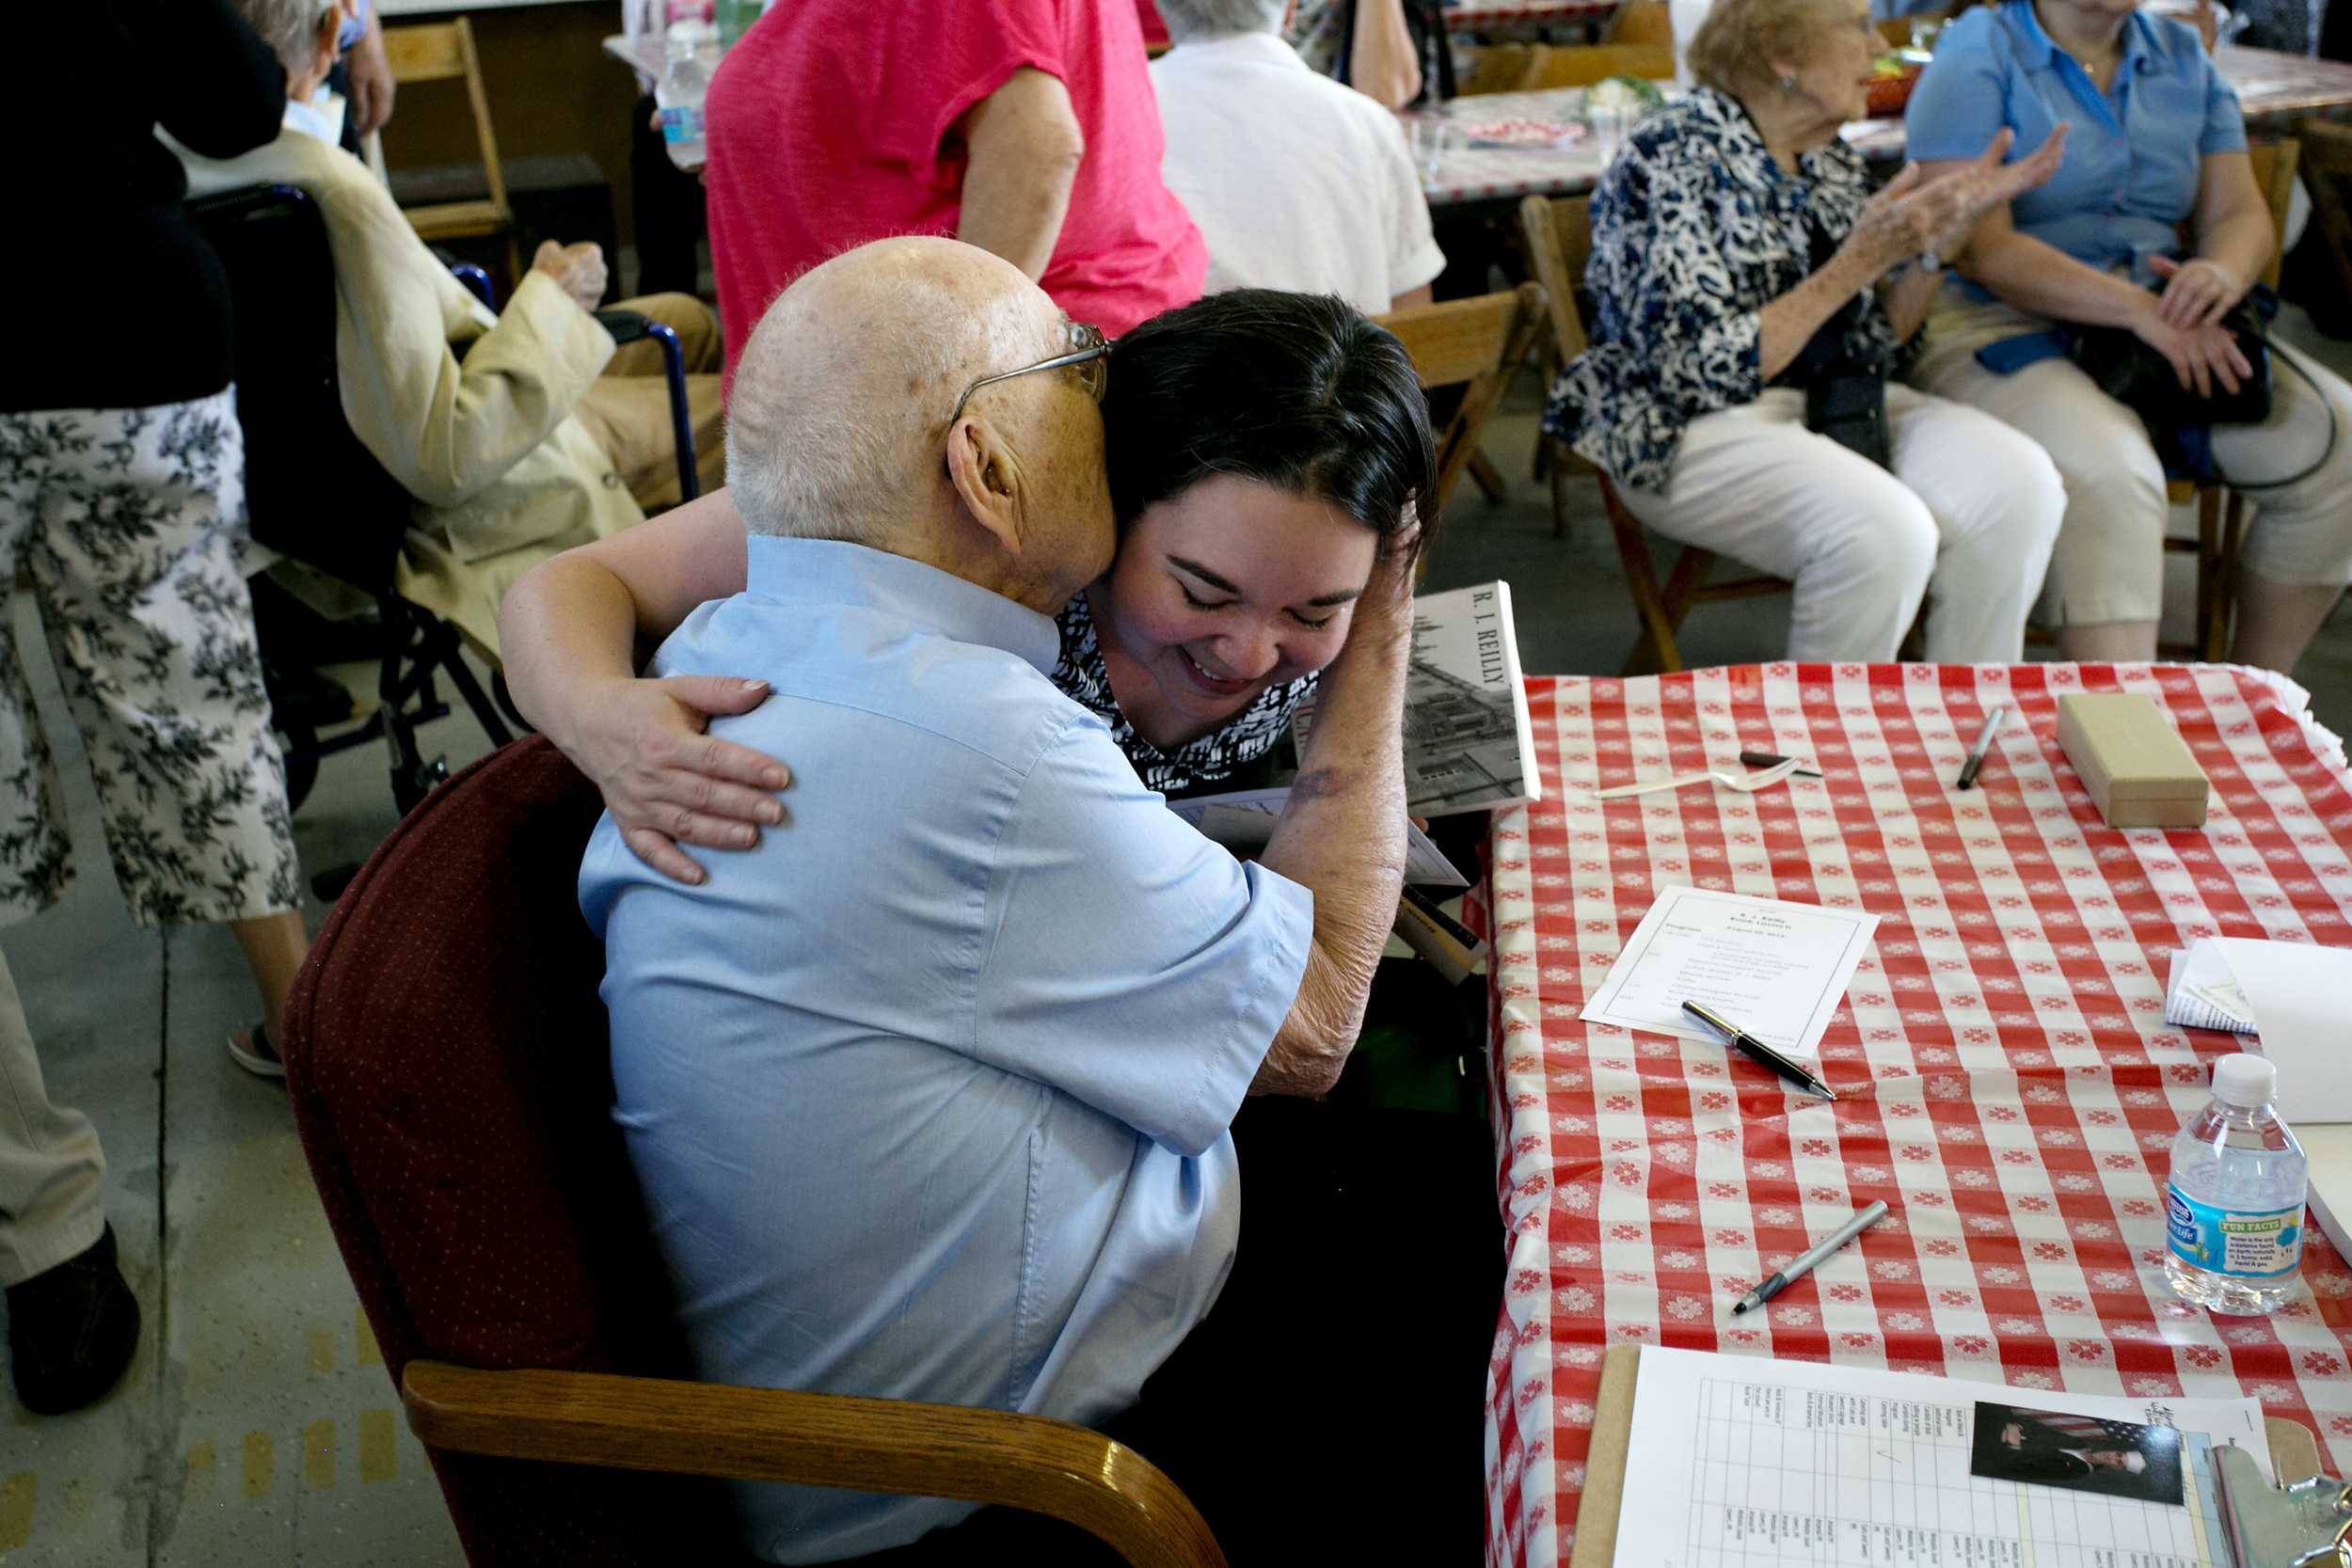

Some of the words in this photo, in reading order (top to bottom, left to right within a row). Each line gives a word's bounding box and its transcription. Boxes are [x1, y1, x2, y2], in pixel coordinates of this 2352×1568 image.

[1473, 592, 1493, 608] R.
[1474, 613, 1495, 624] J.
[1477, 629, 1504, 683] REILLY
[1665, 923, 1701, 933] Program
[2223, 1222, 2245, 1231] FUN
[2248, 1220, 2280, 1231] FACTS
